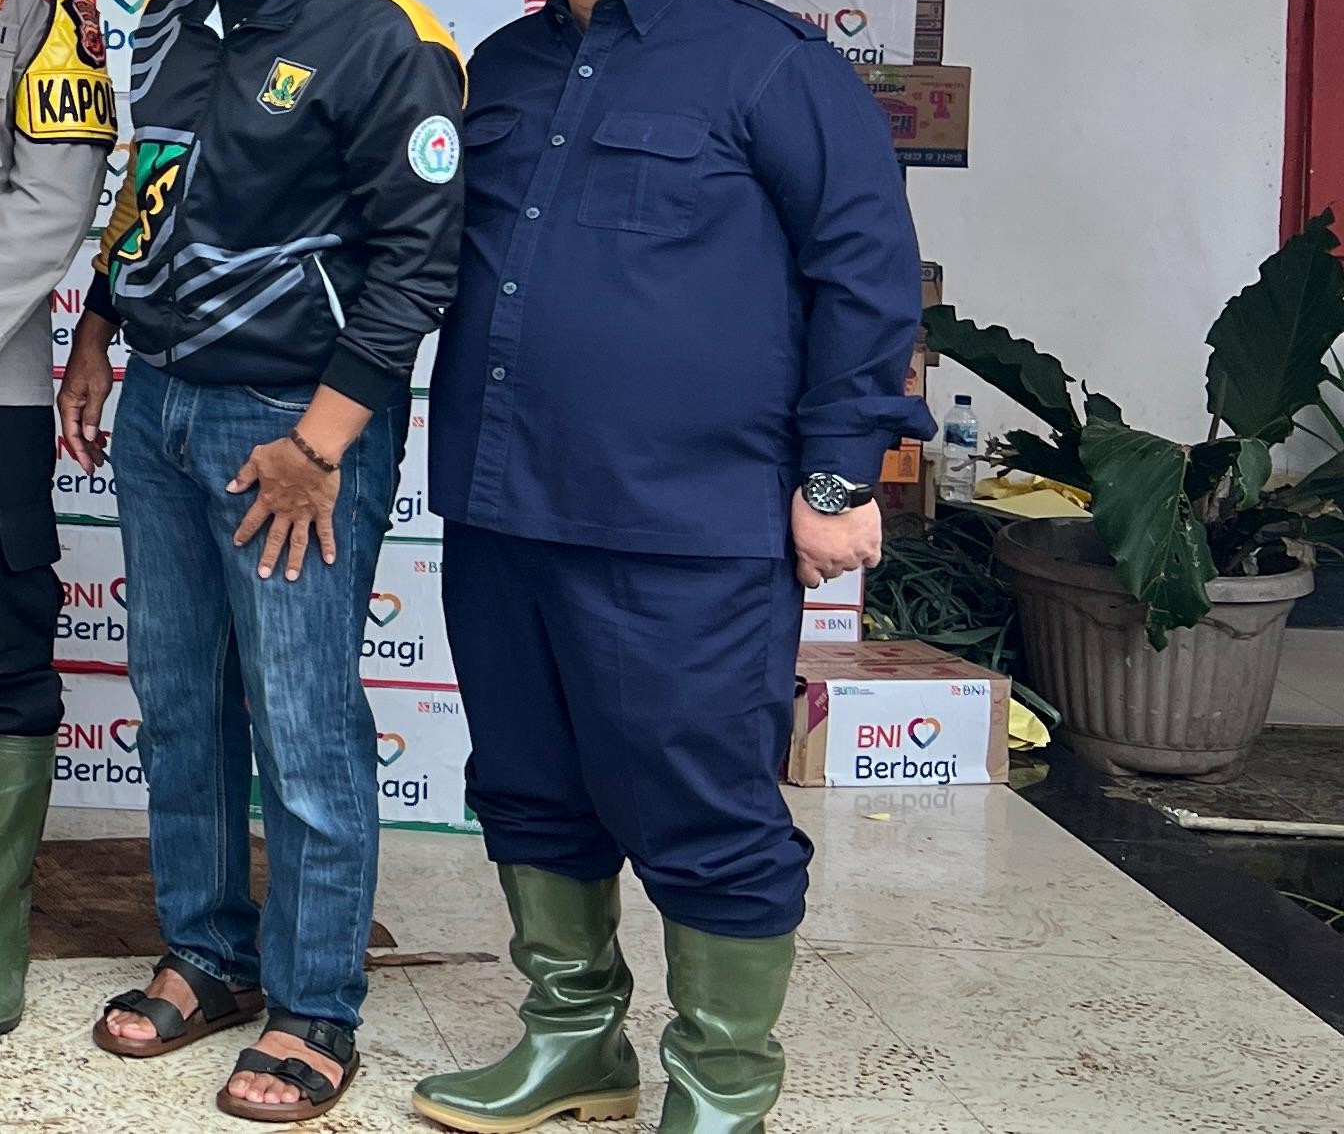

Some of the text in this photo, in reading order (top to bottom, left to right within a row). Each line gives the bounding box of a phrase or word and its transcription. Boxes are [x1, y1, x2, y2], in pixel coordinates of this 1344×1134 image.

[38, 78, 117, 131] KAPOL
[51, 289, 80, 313] NI
[55, 613, 125, 642] Berb
[828, 619, 852, 630] BNI
[359, 635, 424, 667] bagi
[963, 685, 986, 696] BNI
[432, 702, 459, 715] BNI
[56, 722, 103, 750] BNI
[857, 724, 902, 749] BNI
[54, 755, 144, 784] Berba
[855, 754, 958, 785] Berbagi
